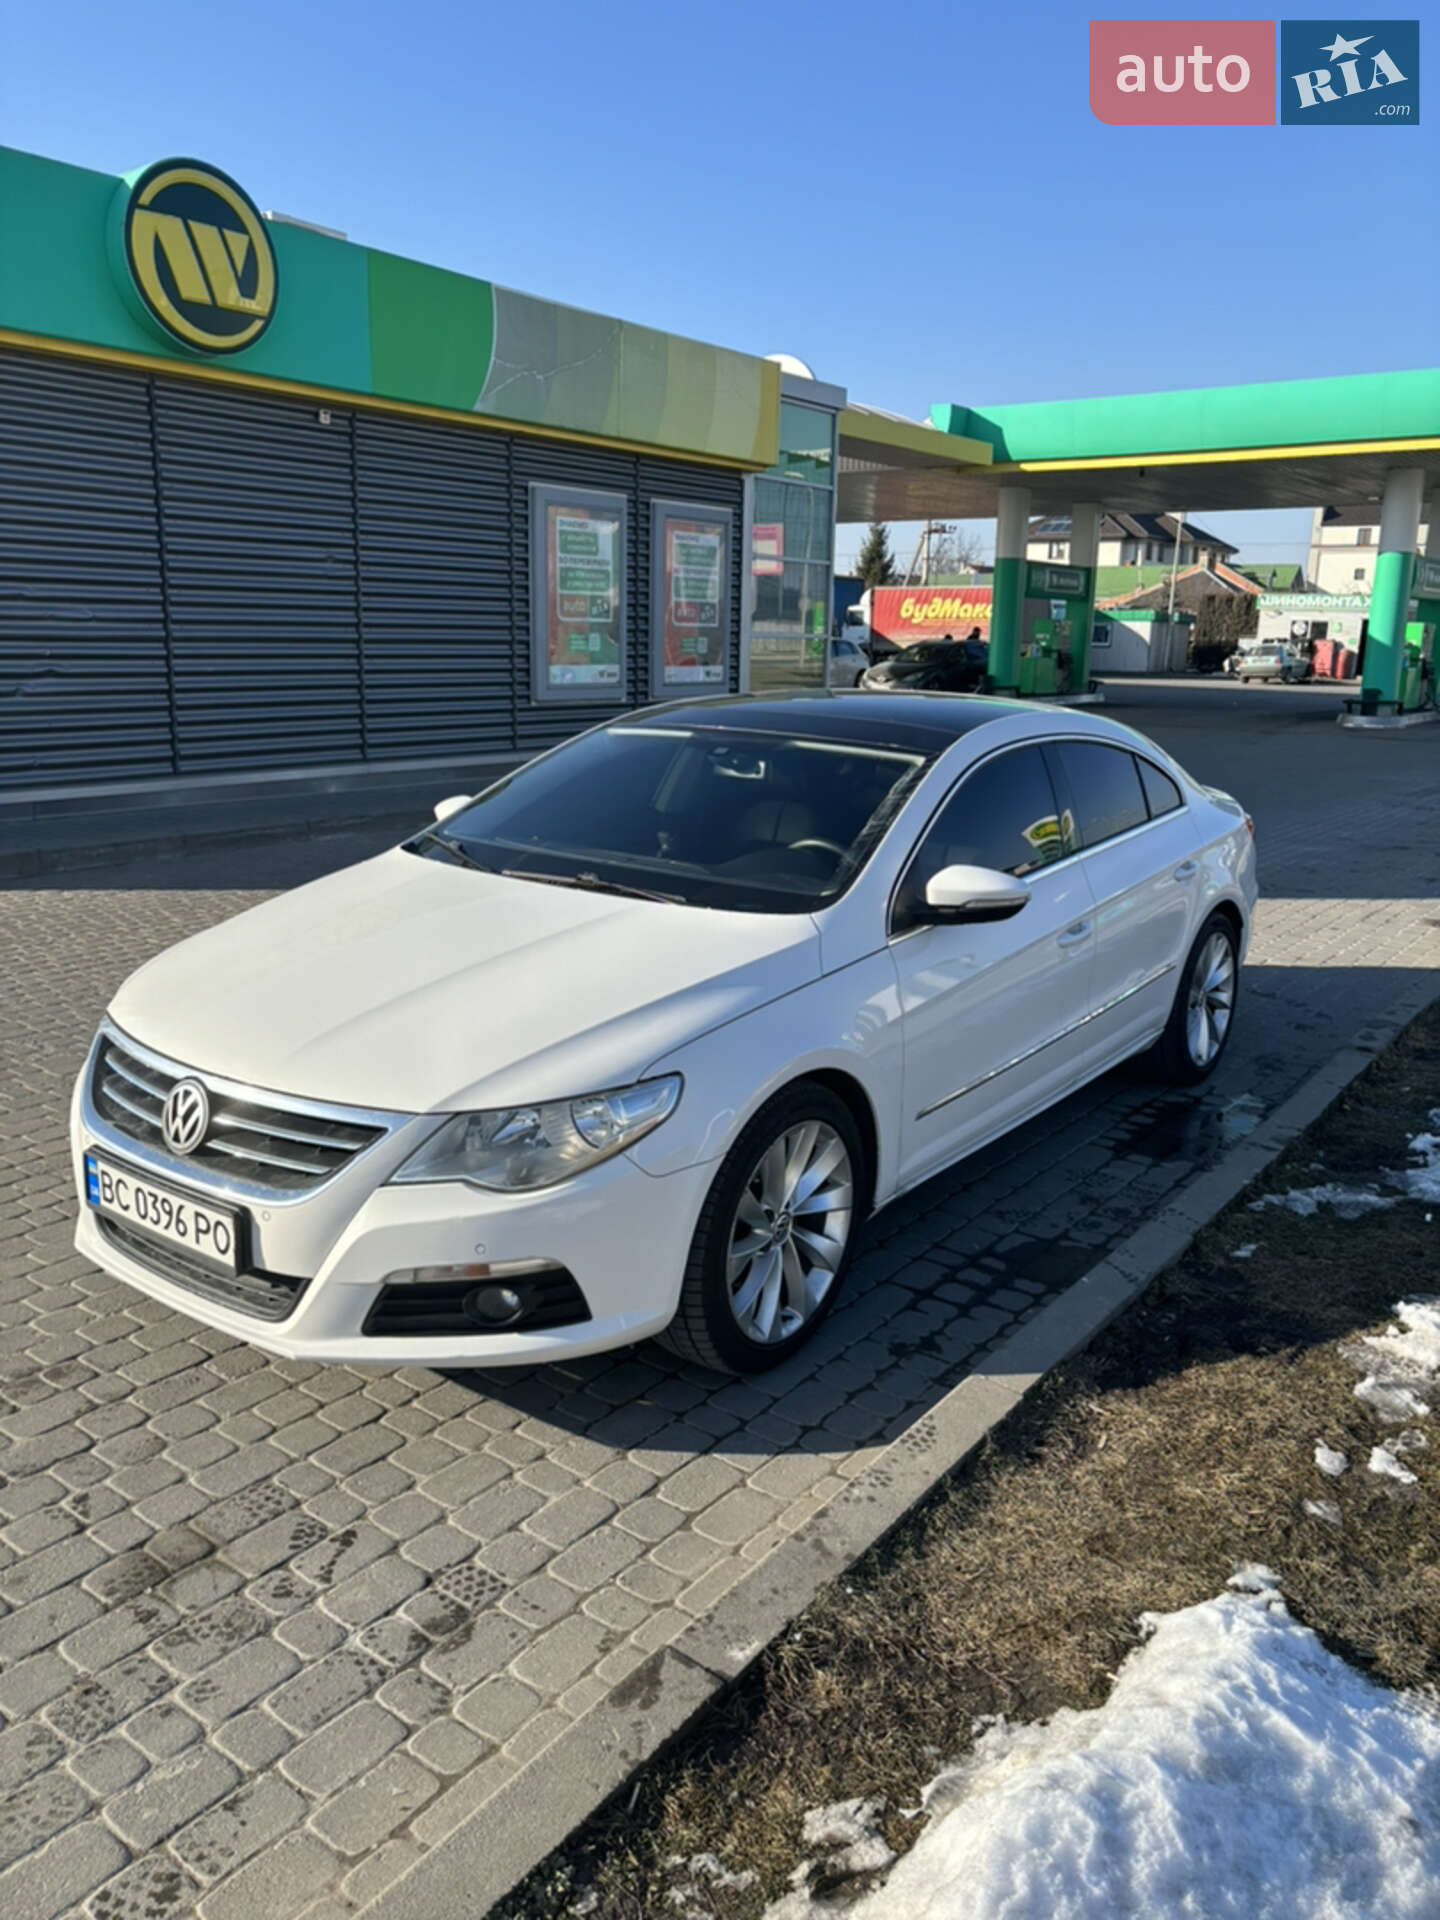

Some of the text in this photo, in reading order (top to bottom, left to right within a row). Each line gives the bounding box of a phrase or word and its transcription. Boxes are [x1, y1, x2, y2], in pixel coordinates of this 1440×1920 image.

[101, 1169, 231, 1256] BC 0396 PO
